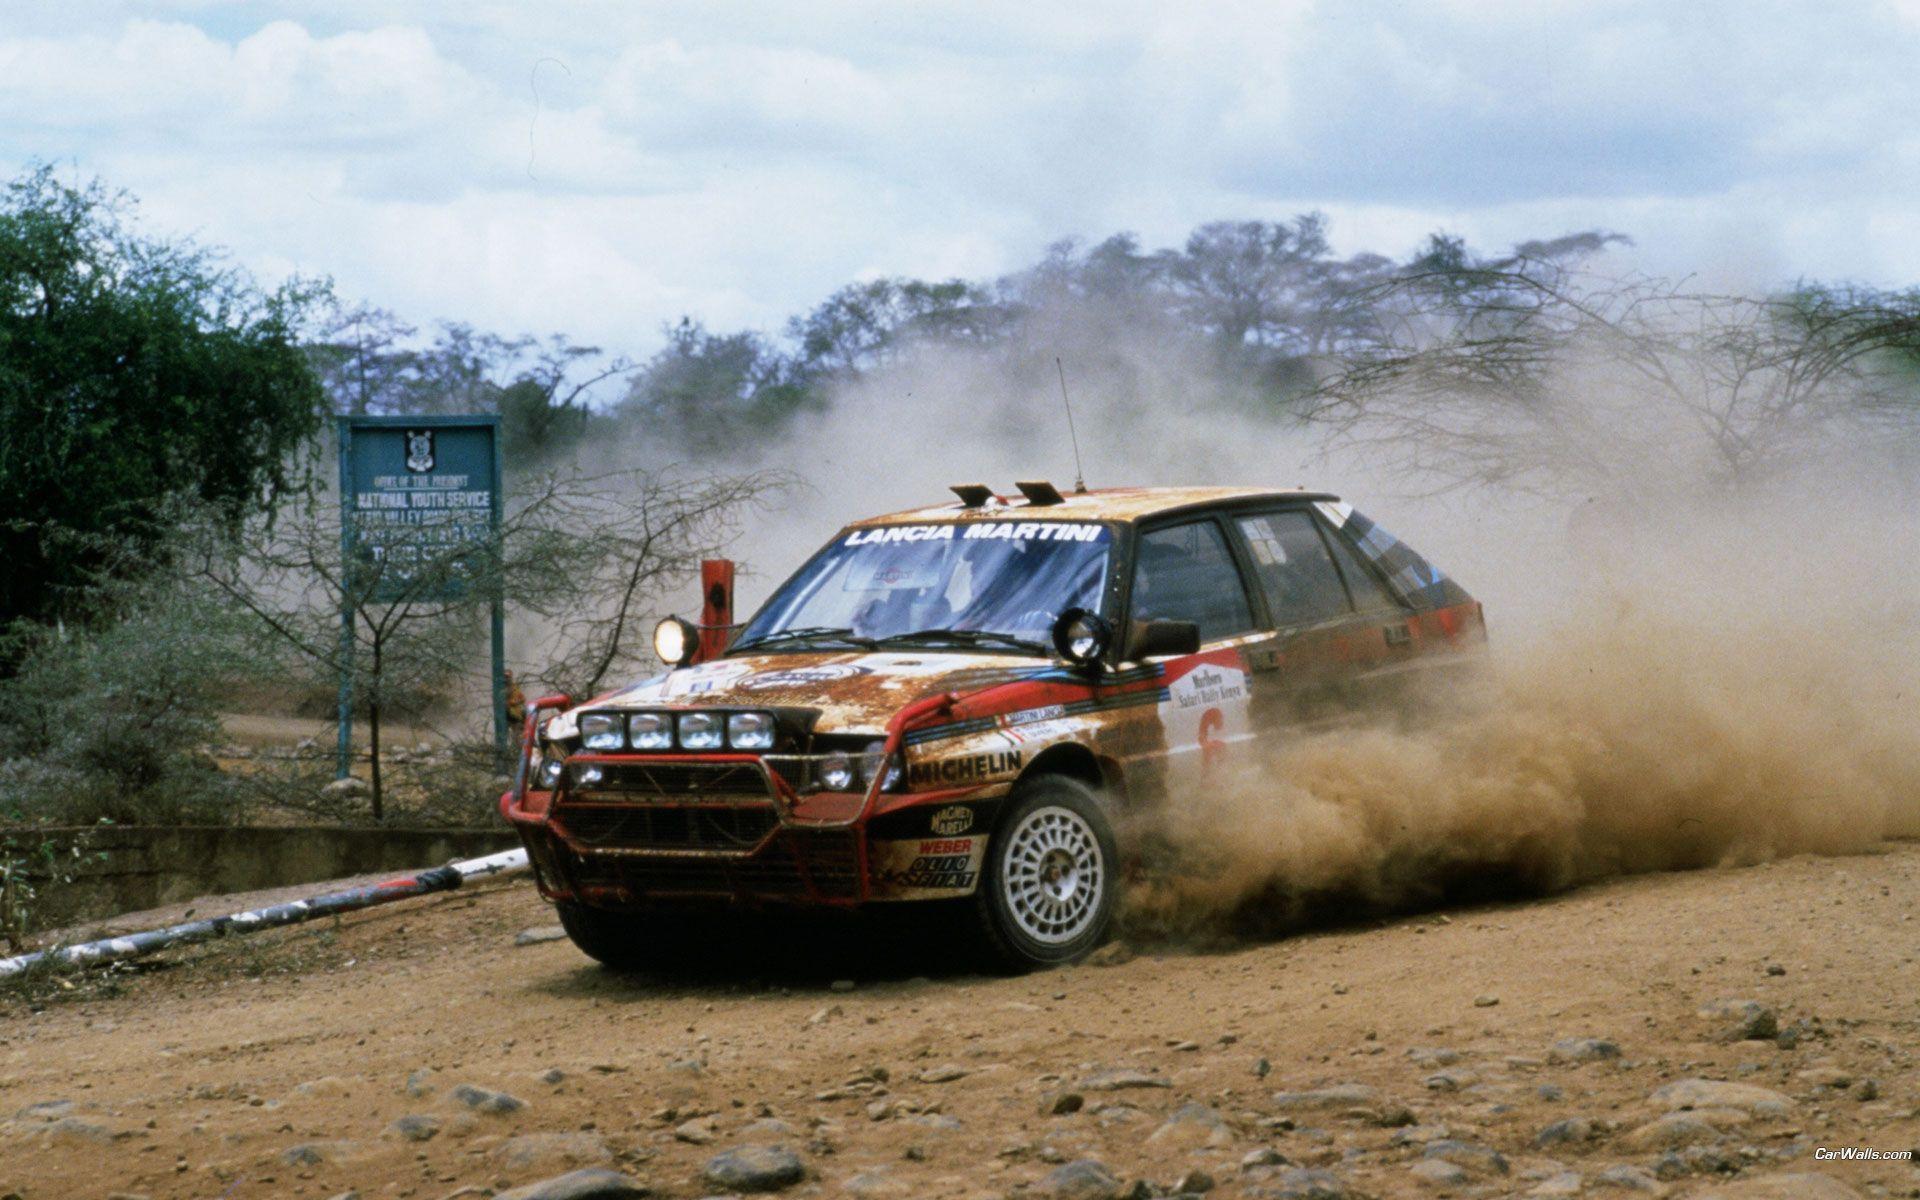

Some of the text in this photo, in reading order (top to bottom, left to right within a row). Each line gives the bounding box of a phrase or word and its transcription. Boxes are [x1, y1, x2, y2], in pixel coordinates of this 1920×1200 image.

[358, 490, 490, 508] NATIONAL YOUTH SERVICE
[844, 523, 1102, 547] LANCIA MARTINI
[1178, 693, 1199, 708] Safari
[909, 750, 1022, 783] MICHELIN
[920, 839, 972, 855] WEBER
[912, 856, 967, 871] OLIO
[917, 873, 974, 887] FIAT
